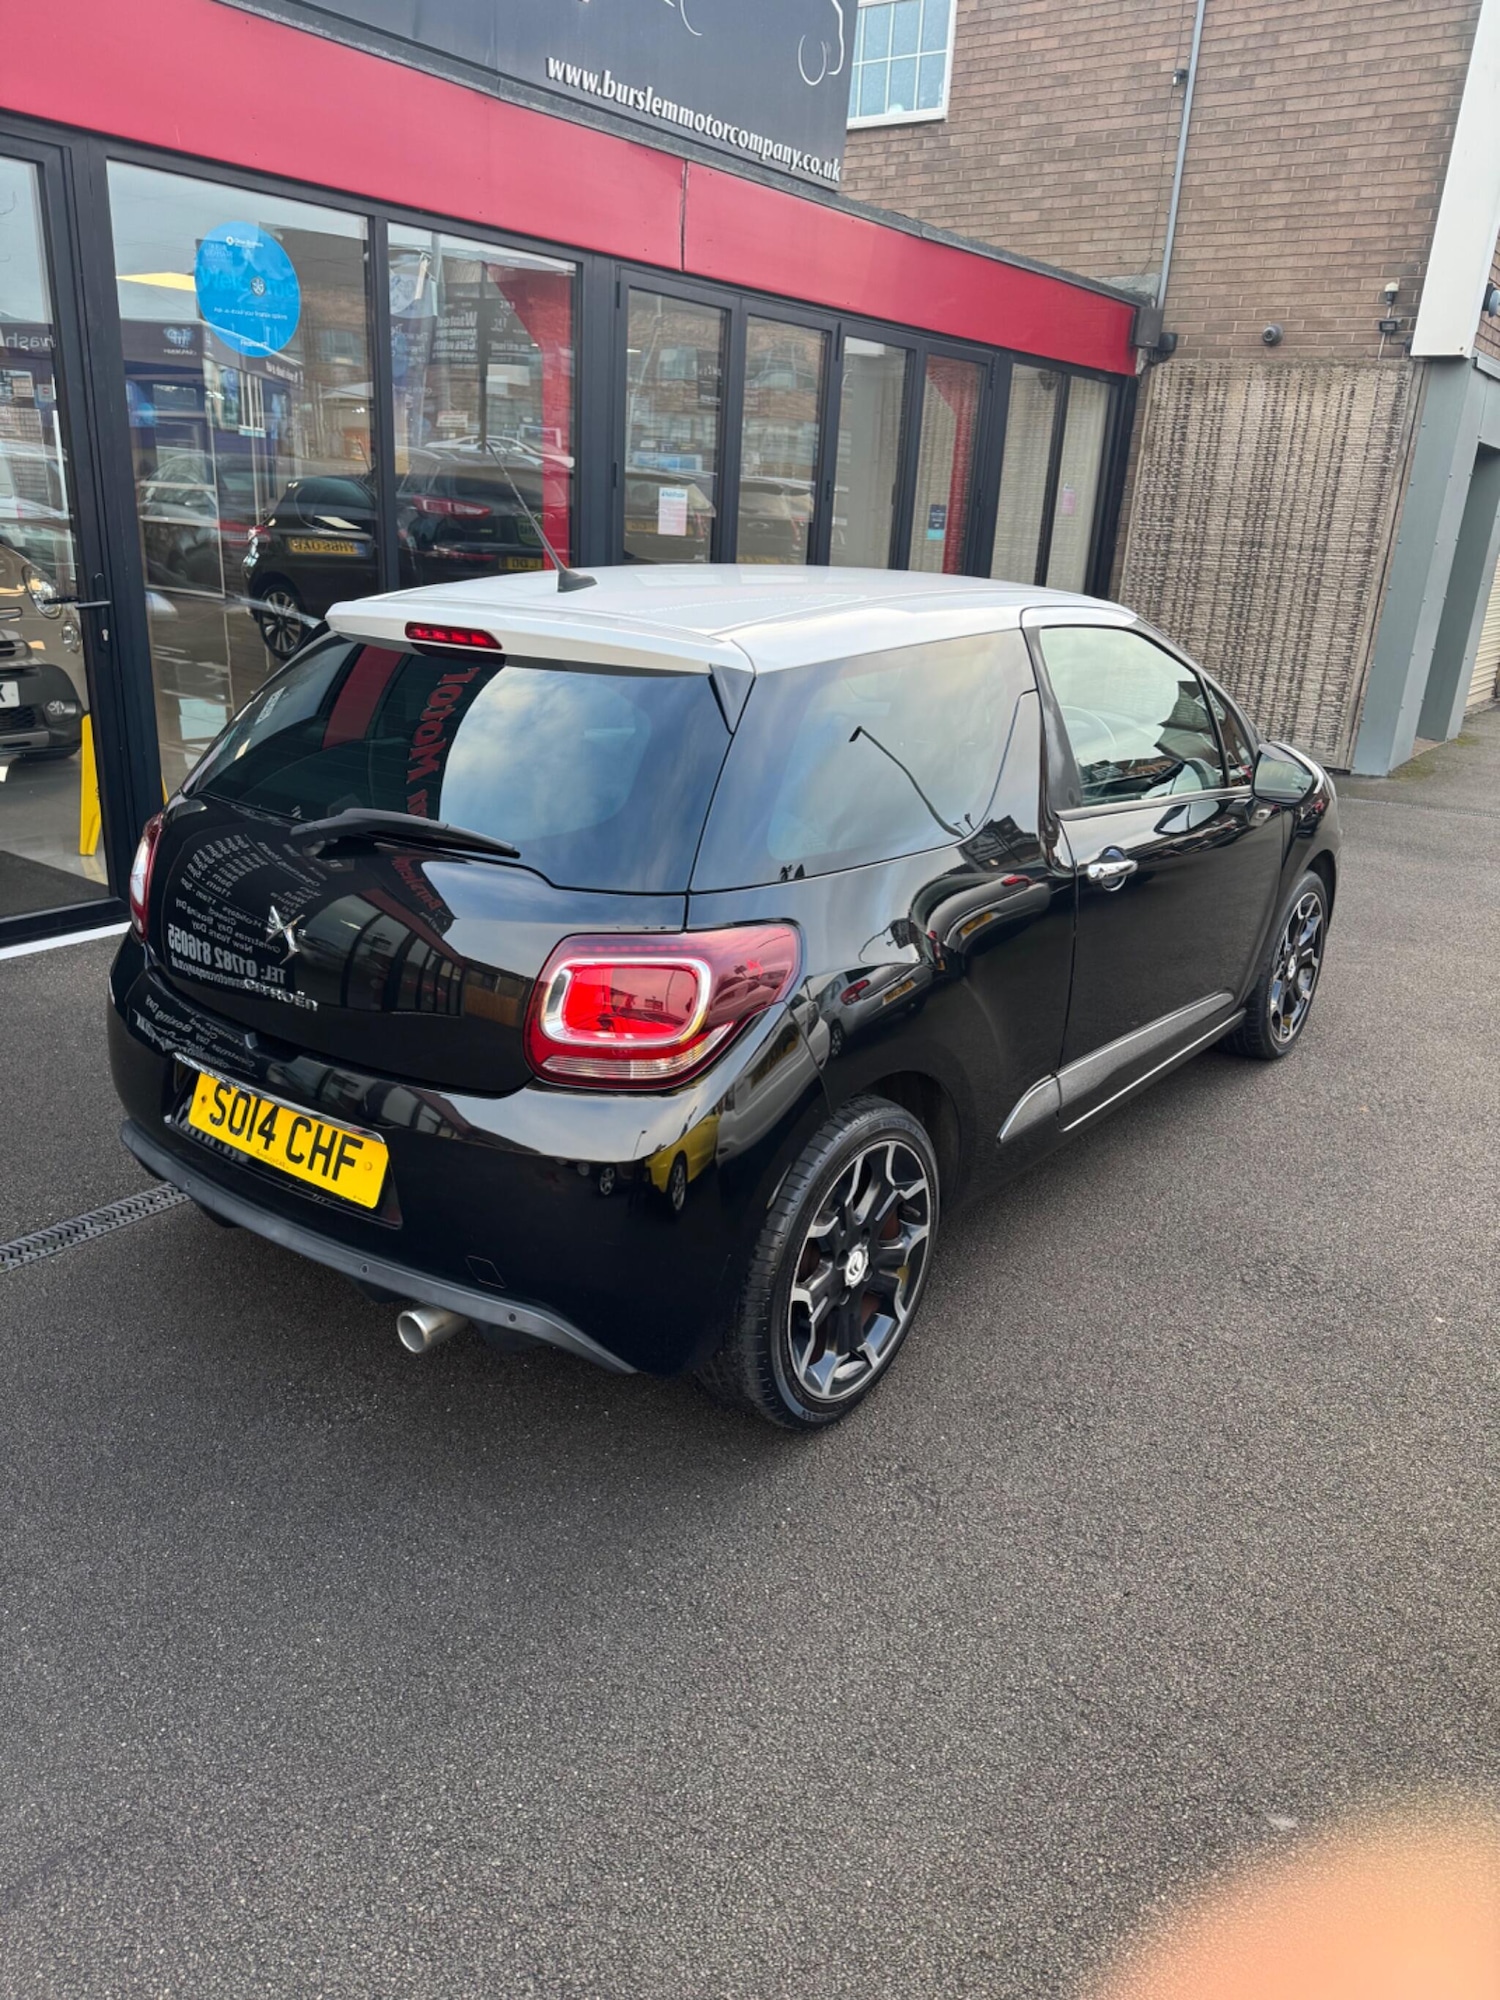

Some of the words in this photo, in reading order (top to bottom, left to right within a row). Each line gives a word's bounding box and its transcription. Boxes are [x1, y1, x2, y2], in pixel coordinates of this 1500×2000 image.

[546, 56, 841, 183] www.burslemmotorcompany.co.uk
[209, 1081, 281, 1152] SO14
[285, 1115, 364, 1182] CHF
